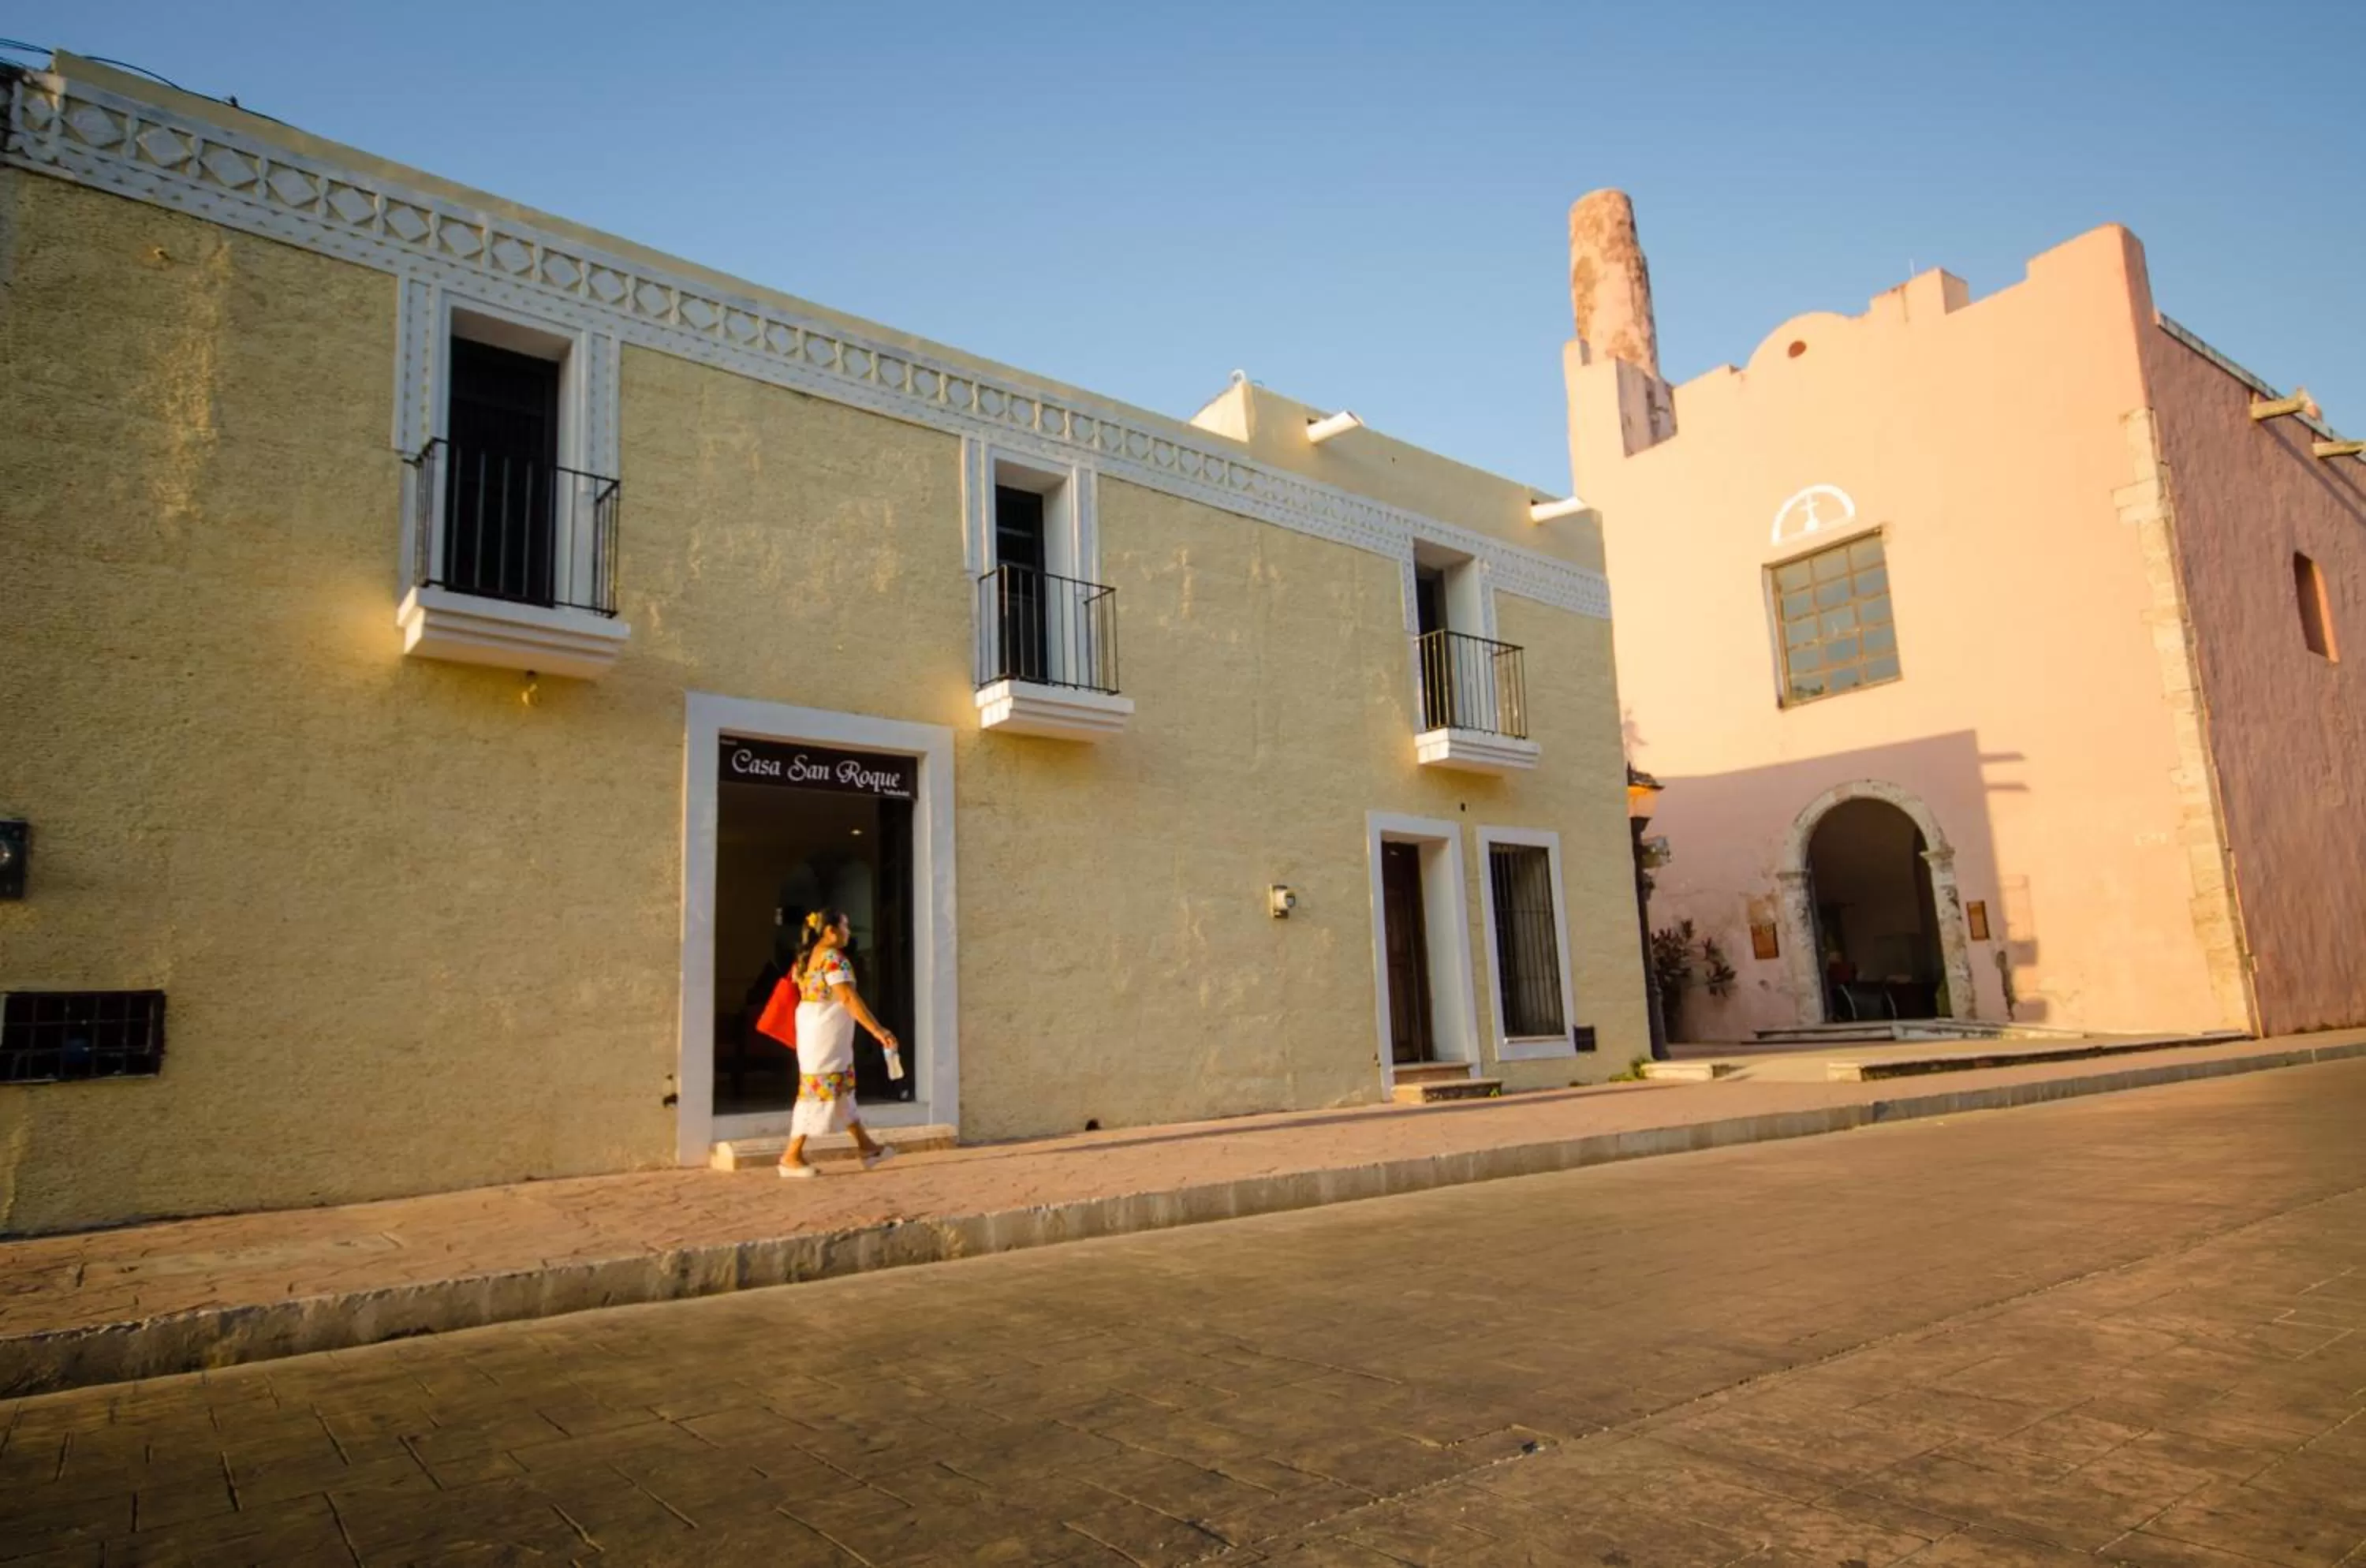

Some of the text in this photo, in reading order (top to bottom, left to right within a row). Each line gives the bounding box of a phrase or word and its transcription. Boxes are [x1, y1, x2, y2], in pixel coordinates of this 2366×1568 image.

[731, 749, 900, 793] Casa San Roque
